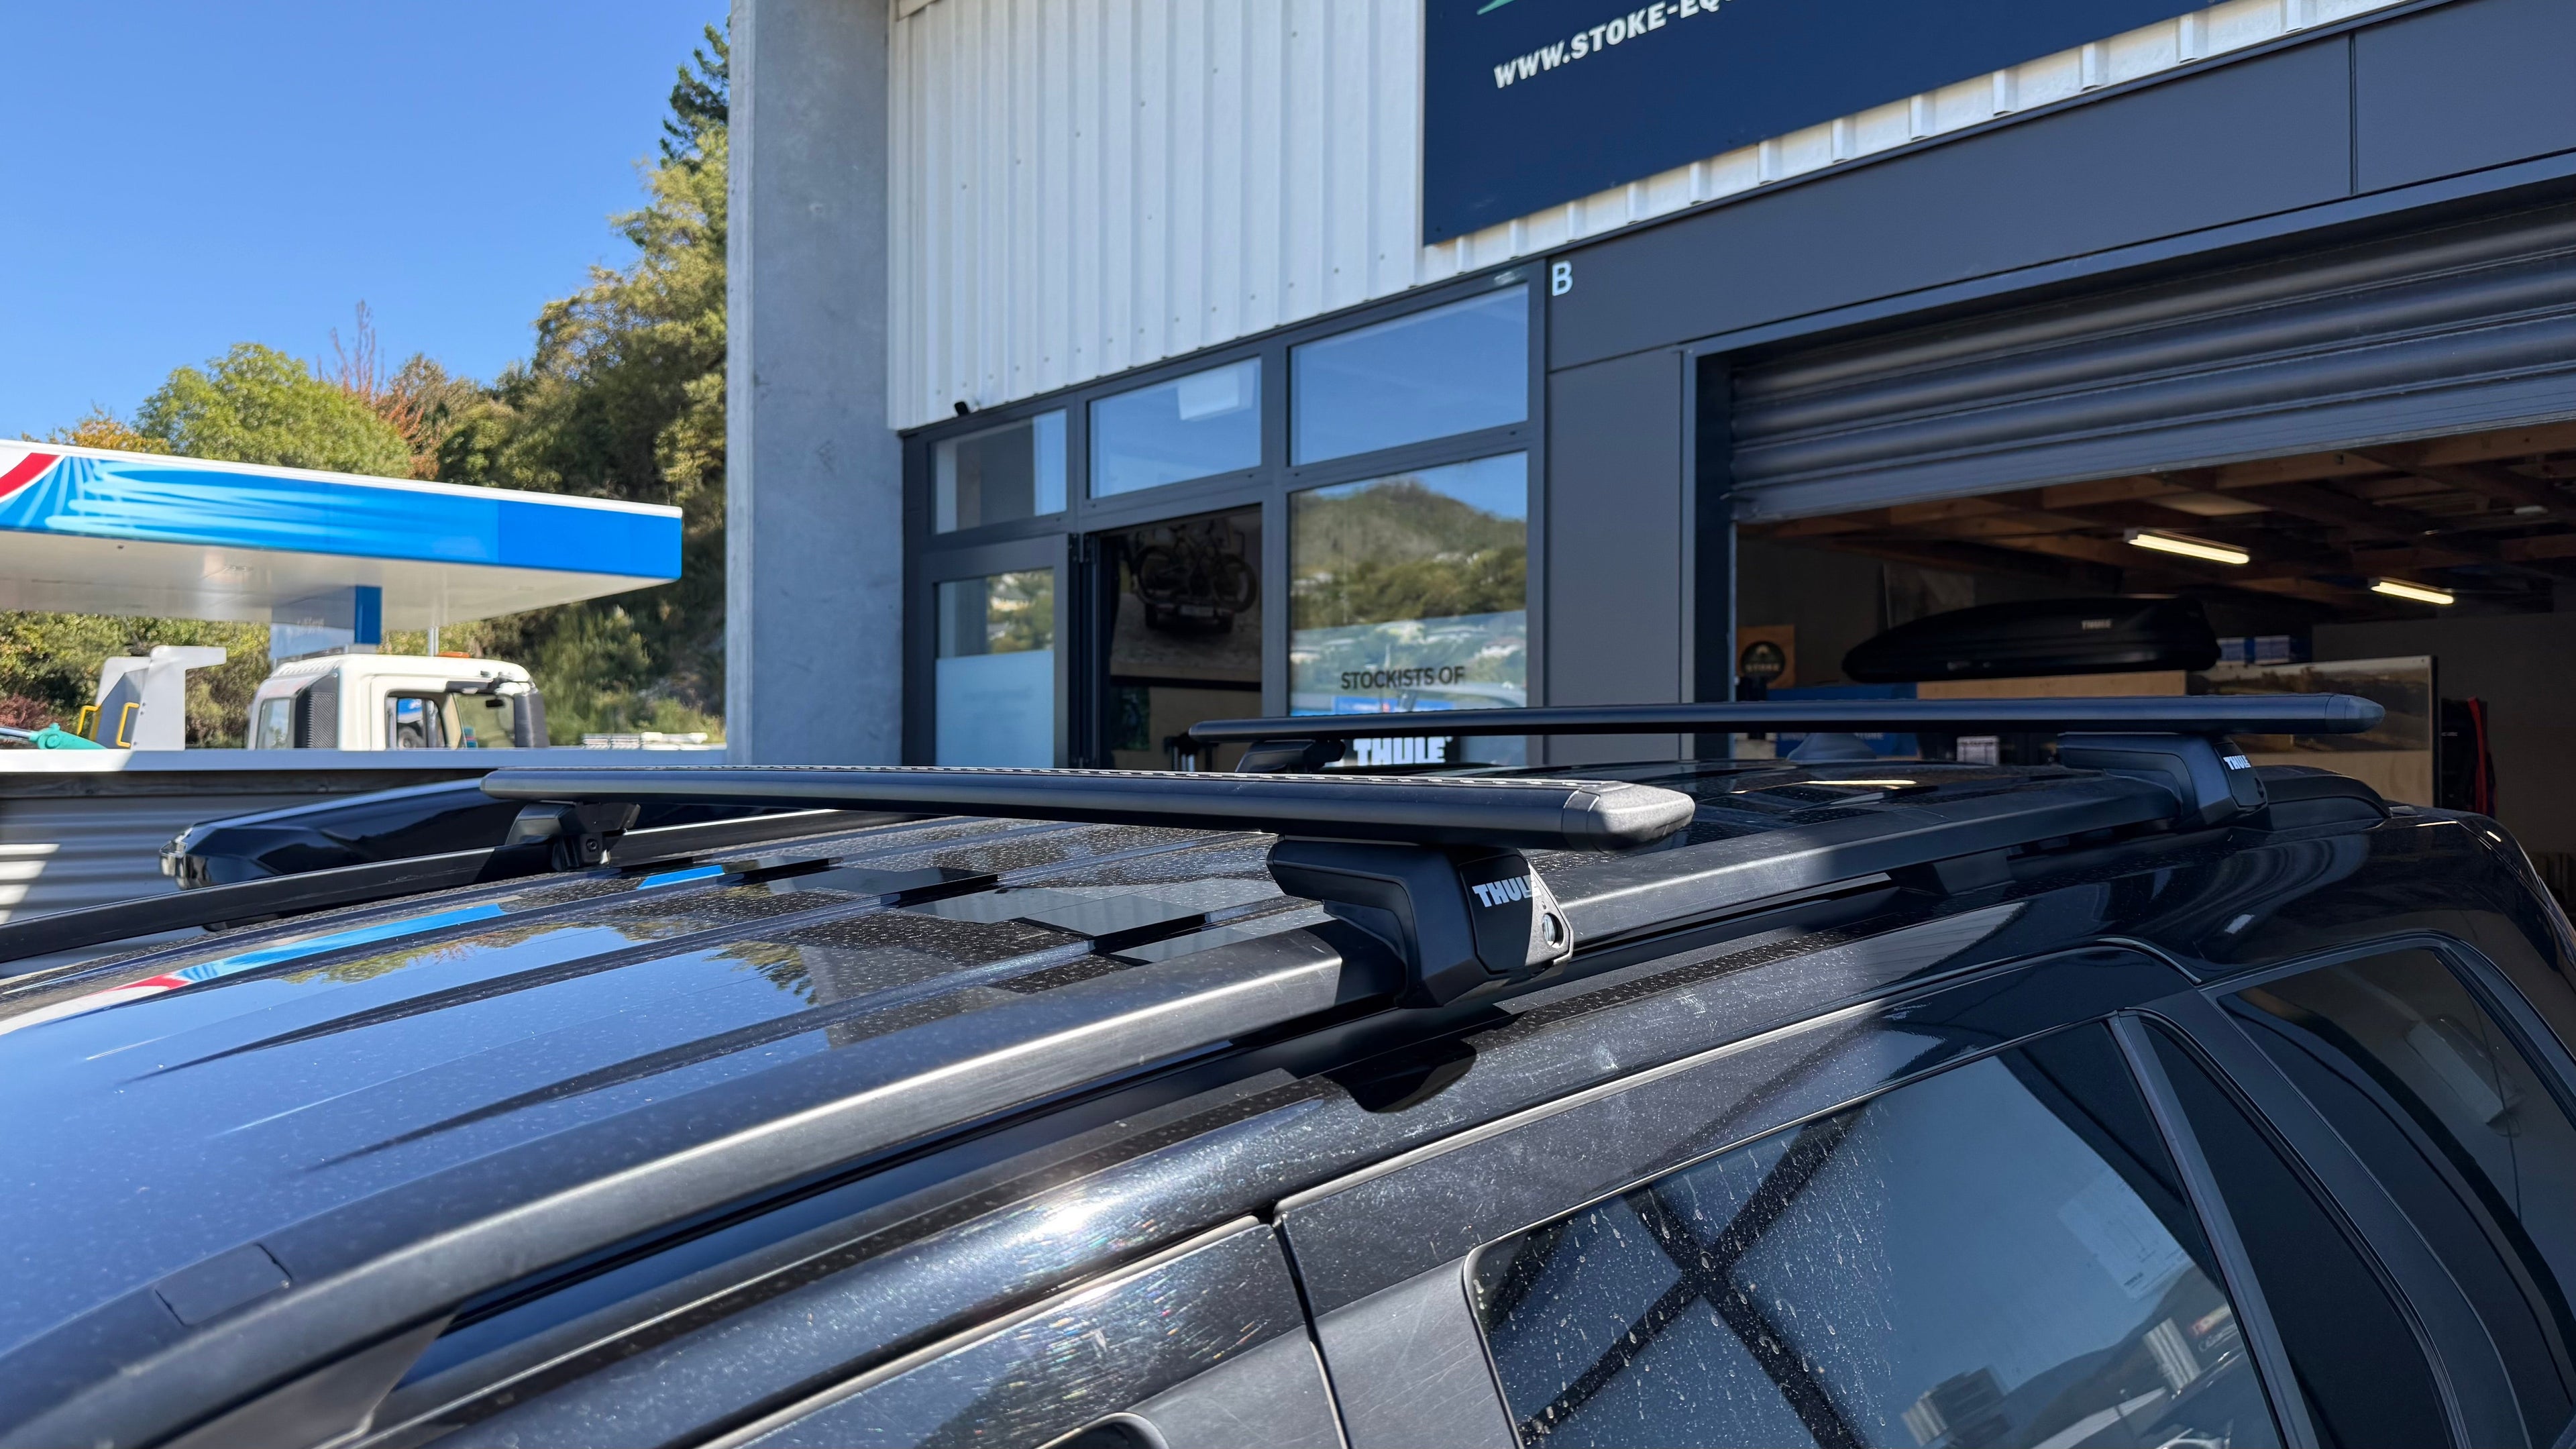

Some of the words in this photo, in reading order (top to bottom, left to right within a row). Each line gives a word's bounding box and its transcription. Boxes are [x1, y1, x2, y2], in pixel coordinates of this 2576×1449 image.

[1493, 0, 1731, 89] WWW.STOKE-E
[1552, 261, 1572, 297] B
[1341, 667, 1434, 690] STOCKISTS
[1438, 666, 1465, 684] OF
[1353, 737, 1446, 766] THULE
[2223, 755, 2251, 770] THULE
